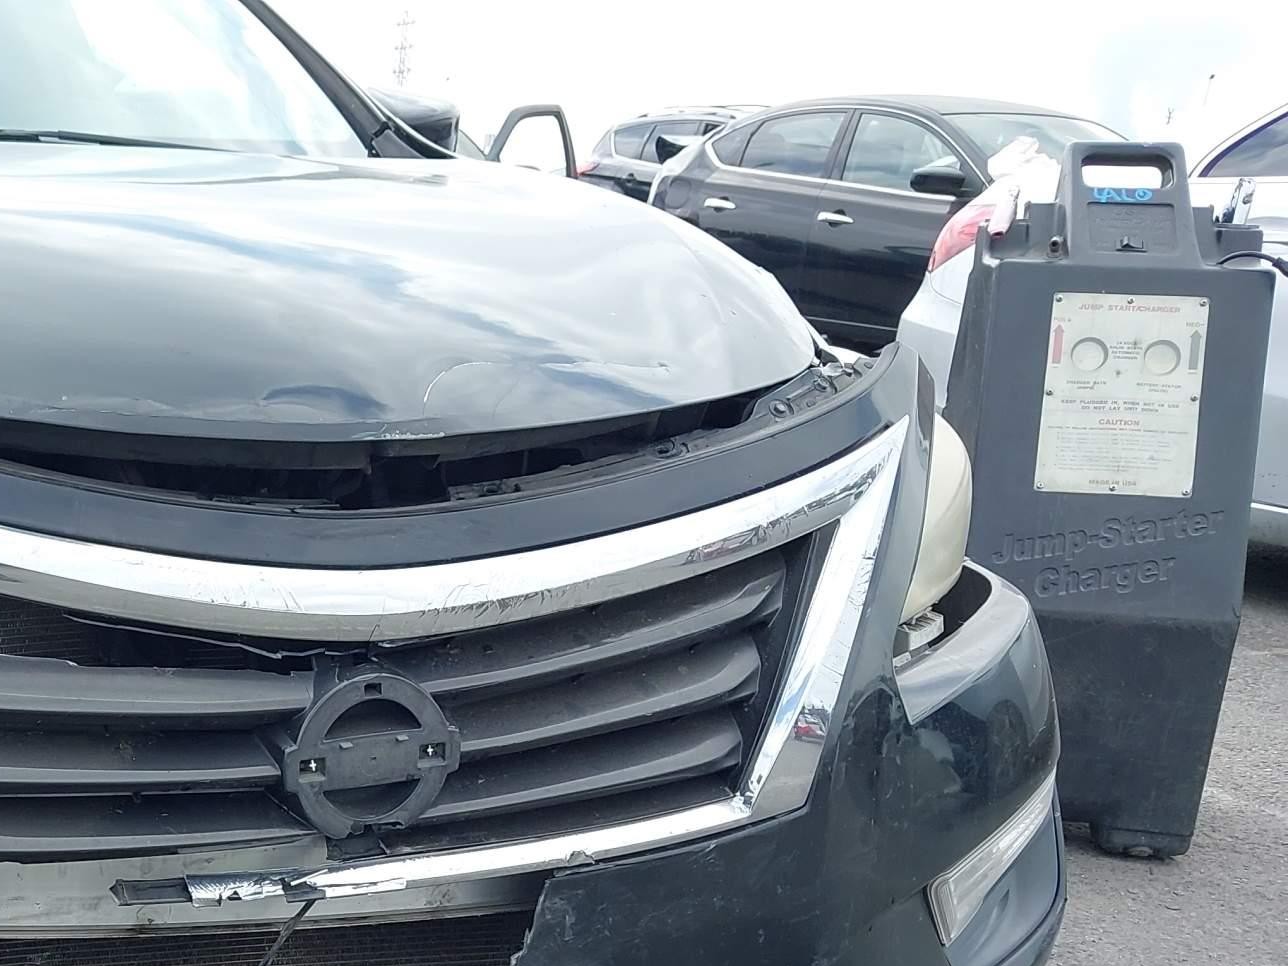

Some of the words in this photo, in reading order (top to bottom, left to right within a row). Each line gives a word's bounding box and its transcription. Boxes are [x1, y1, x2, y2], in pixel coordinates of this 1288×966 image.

[1078, 303, 1104, 311] JUMP
[1108, 304, 1181, 313] START/CHARGER
[1098, 418, 1140, 426] CAUTION
[991, 509, 1225, 565] Jump-Starter
[1033, 556, 1177, 598] Charger
